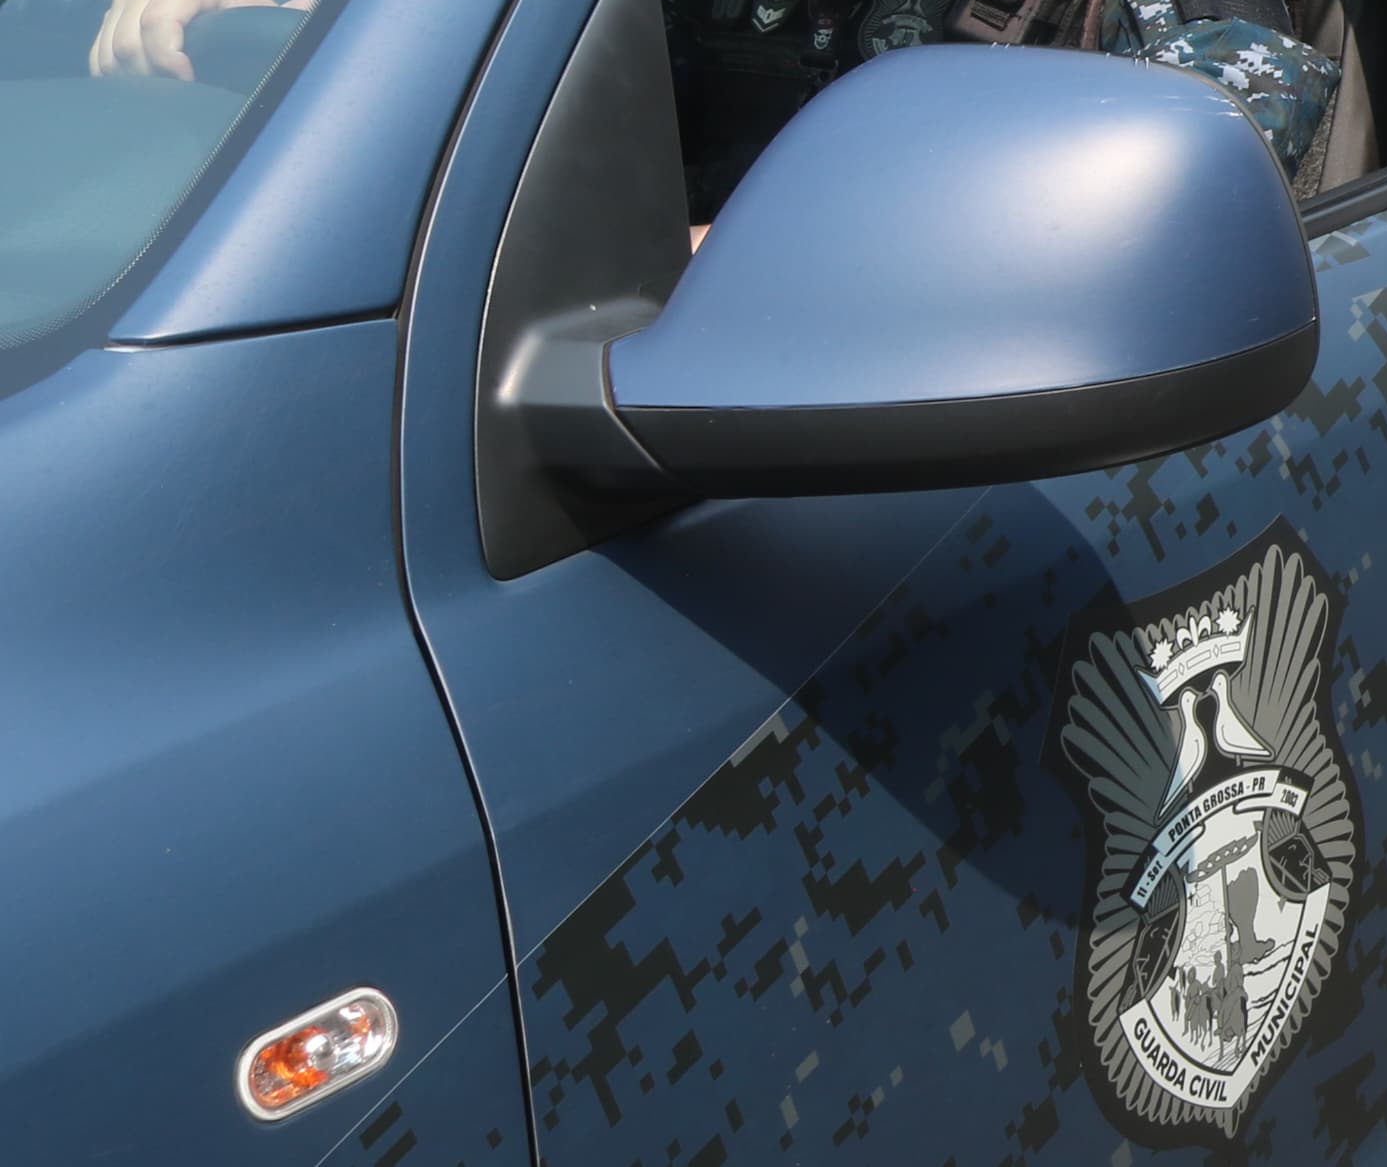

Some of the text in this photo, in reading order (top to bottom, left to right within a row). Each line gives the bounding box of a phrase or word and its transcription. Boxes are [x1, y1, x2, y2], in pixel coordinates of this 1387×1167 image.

[1167, 805, 1202, 842] PONTA
[1203, 782, 1246, 813] GROSSA
[1251, 776, 1266, 791] PR
[1251, 922, 1320, 1068] MUNICIPAL
[1134, 1016, 1228, 1102] GUARDA CIVIL
